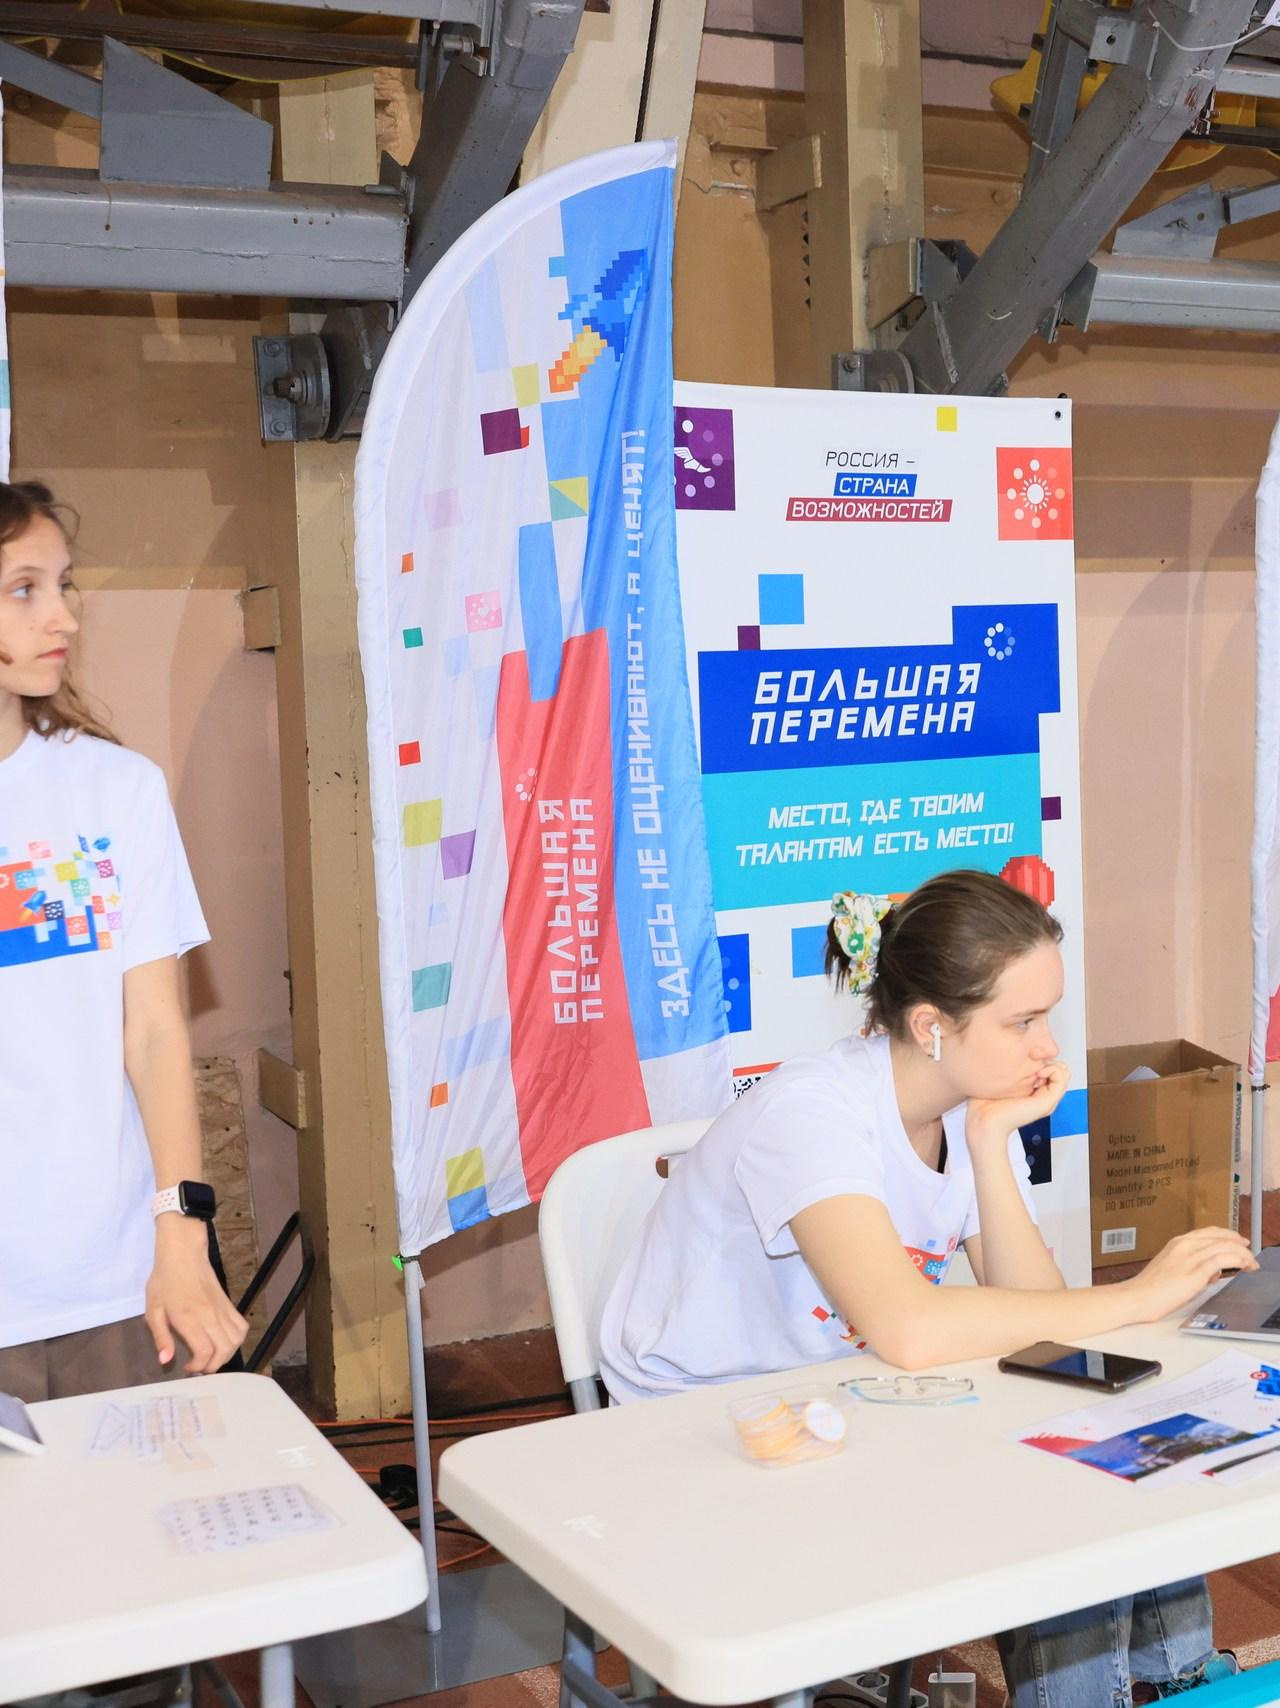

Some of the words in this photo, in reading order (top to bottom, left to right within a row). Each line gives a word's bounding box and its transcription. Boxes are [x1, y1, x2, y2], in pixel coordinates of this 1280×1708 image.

[825, 451, 899, 468] РОССИЯ
[621, 430, 646, 557] ЦЕНЯТ!
[839, 477, 910, 495] СТРАНА
[791, 500, 945, 519] ВОЗМОЖНОСТЕЙ
[627, 572, 641, 595] А
[755, 663, 981, 704] БОЛЬШАЯ
[626, 607, 664, 834] ОЦЕНИВАЮТ,
[750, 701, 975, 744] ПЕРЕМЕНА
[768, 802, 851, 828] МЕСТО,
[859, 798, 901, 825] ГДЕ
[909, 792, 984, 817] ТВОИМ
[735, 835, 864, 867] ТАЛАНТАМ
[873, 830, 928, 855] ЕСТЬ
[936, 822, 1014, 849] МЕСТО!
[637, 849, 670, 889] НЕ
[537, 800, 578, 1024] БОЛЬШАЯ
[569, 799, 604, 1022] ПЕРЕМЕНА
[647, 904, 691, 1018] ЗДЕСЬ
[1107, 1149, 1131, 1160] MADE
[1133, 1148, 1141, 1158] IN
[1143, 1144, 1166, 1157] CHINA
[1108, 1135, 1136, 1146] Optics
[1105, 1201, 1117, 1212] DO
[1120, 1199, 1134, 1209] NOT
[1136, 1195, 1157, 1207] DROP
